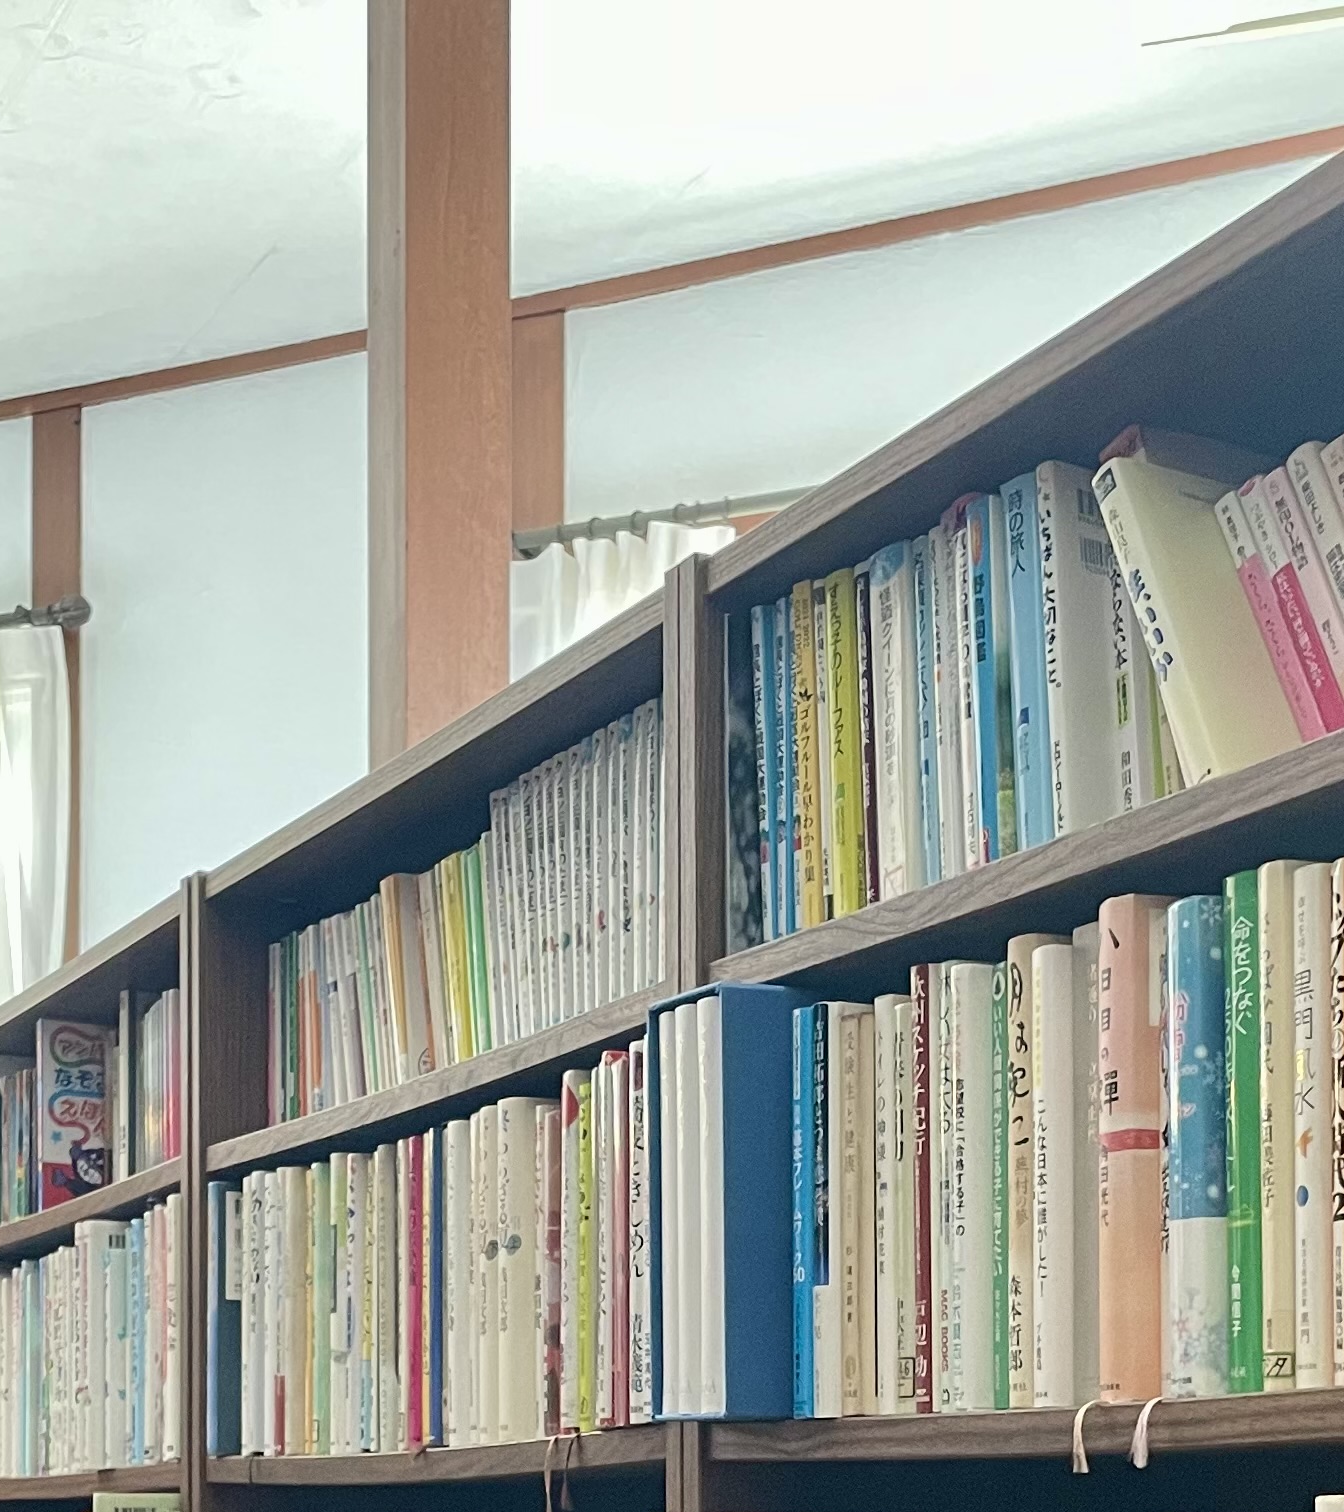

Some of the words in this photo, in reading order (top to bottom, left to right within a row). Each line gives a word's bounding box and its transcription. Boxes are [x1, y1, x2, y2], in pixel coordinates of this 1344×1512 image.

[1007, 488, 1025, 578] 時の旅人
[1232, 916, 1254, 1036] 命をつなぐ
